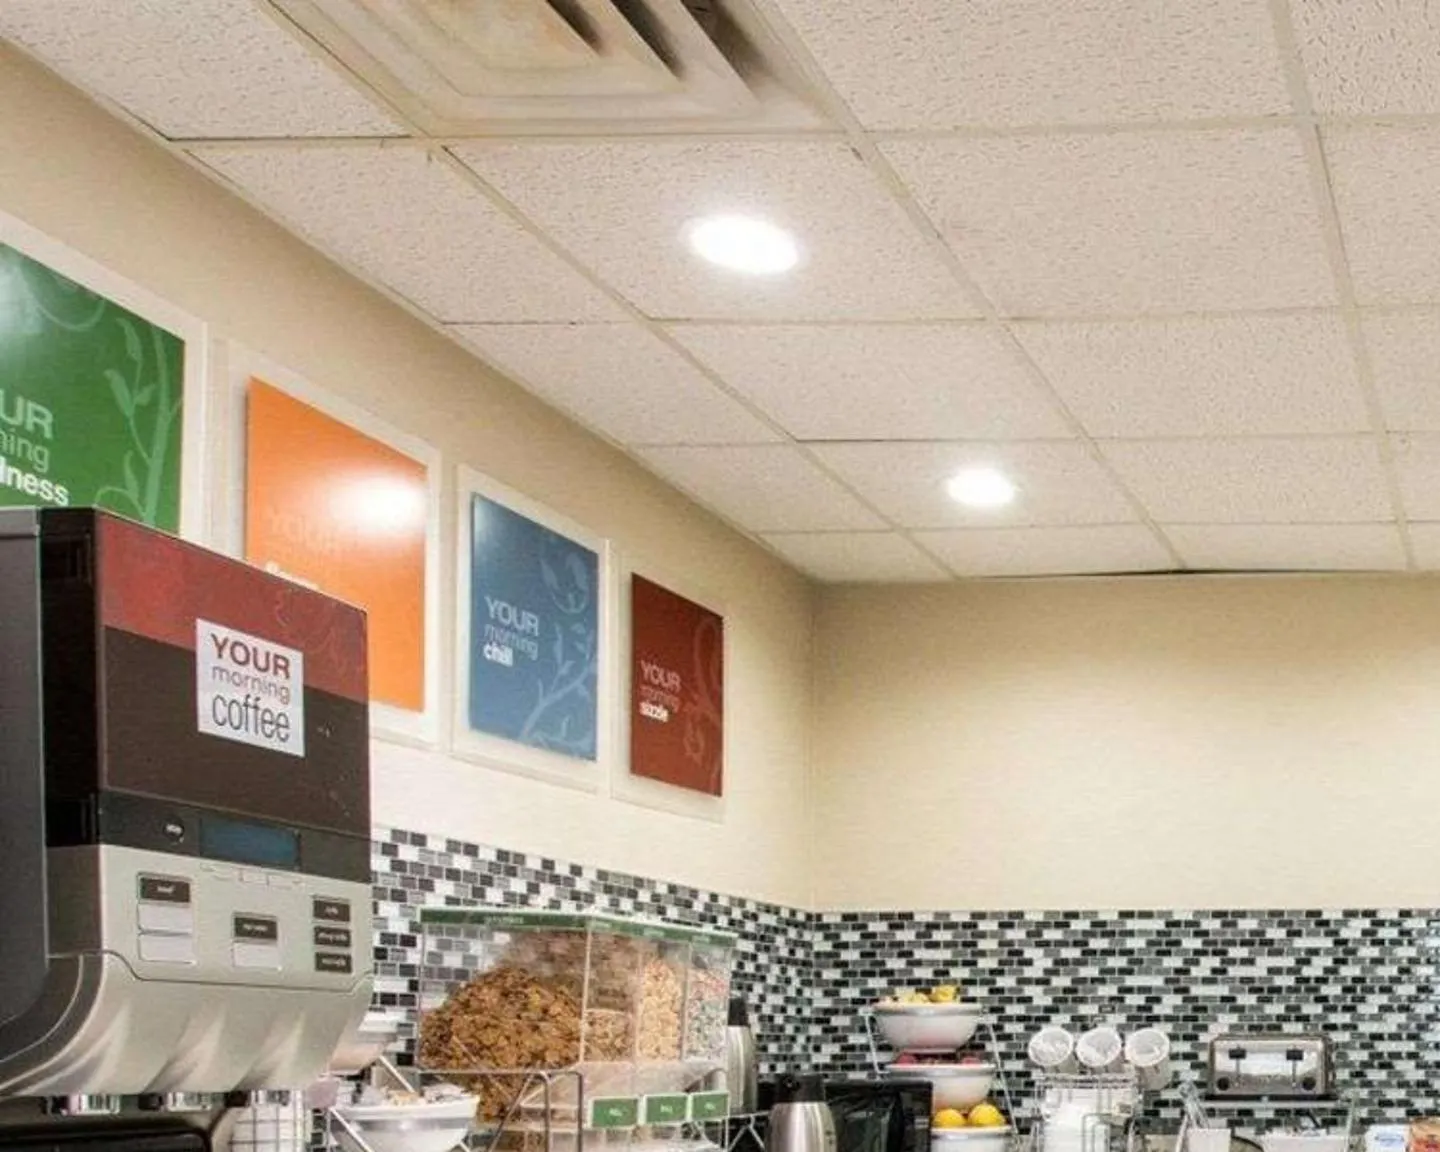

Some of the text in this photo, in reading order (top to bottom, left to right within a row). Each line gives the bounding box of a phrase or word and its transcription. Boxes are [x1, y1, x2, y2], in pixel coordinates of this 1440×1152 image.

[484, 596, 539, 637] YOUR
[210, 632, 290, 679] YOUR
[641, 659, 681, 693] YOUR
[211, 665, 291, 706] morning
[212, 693, 290, 743] coffee
